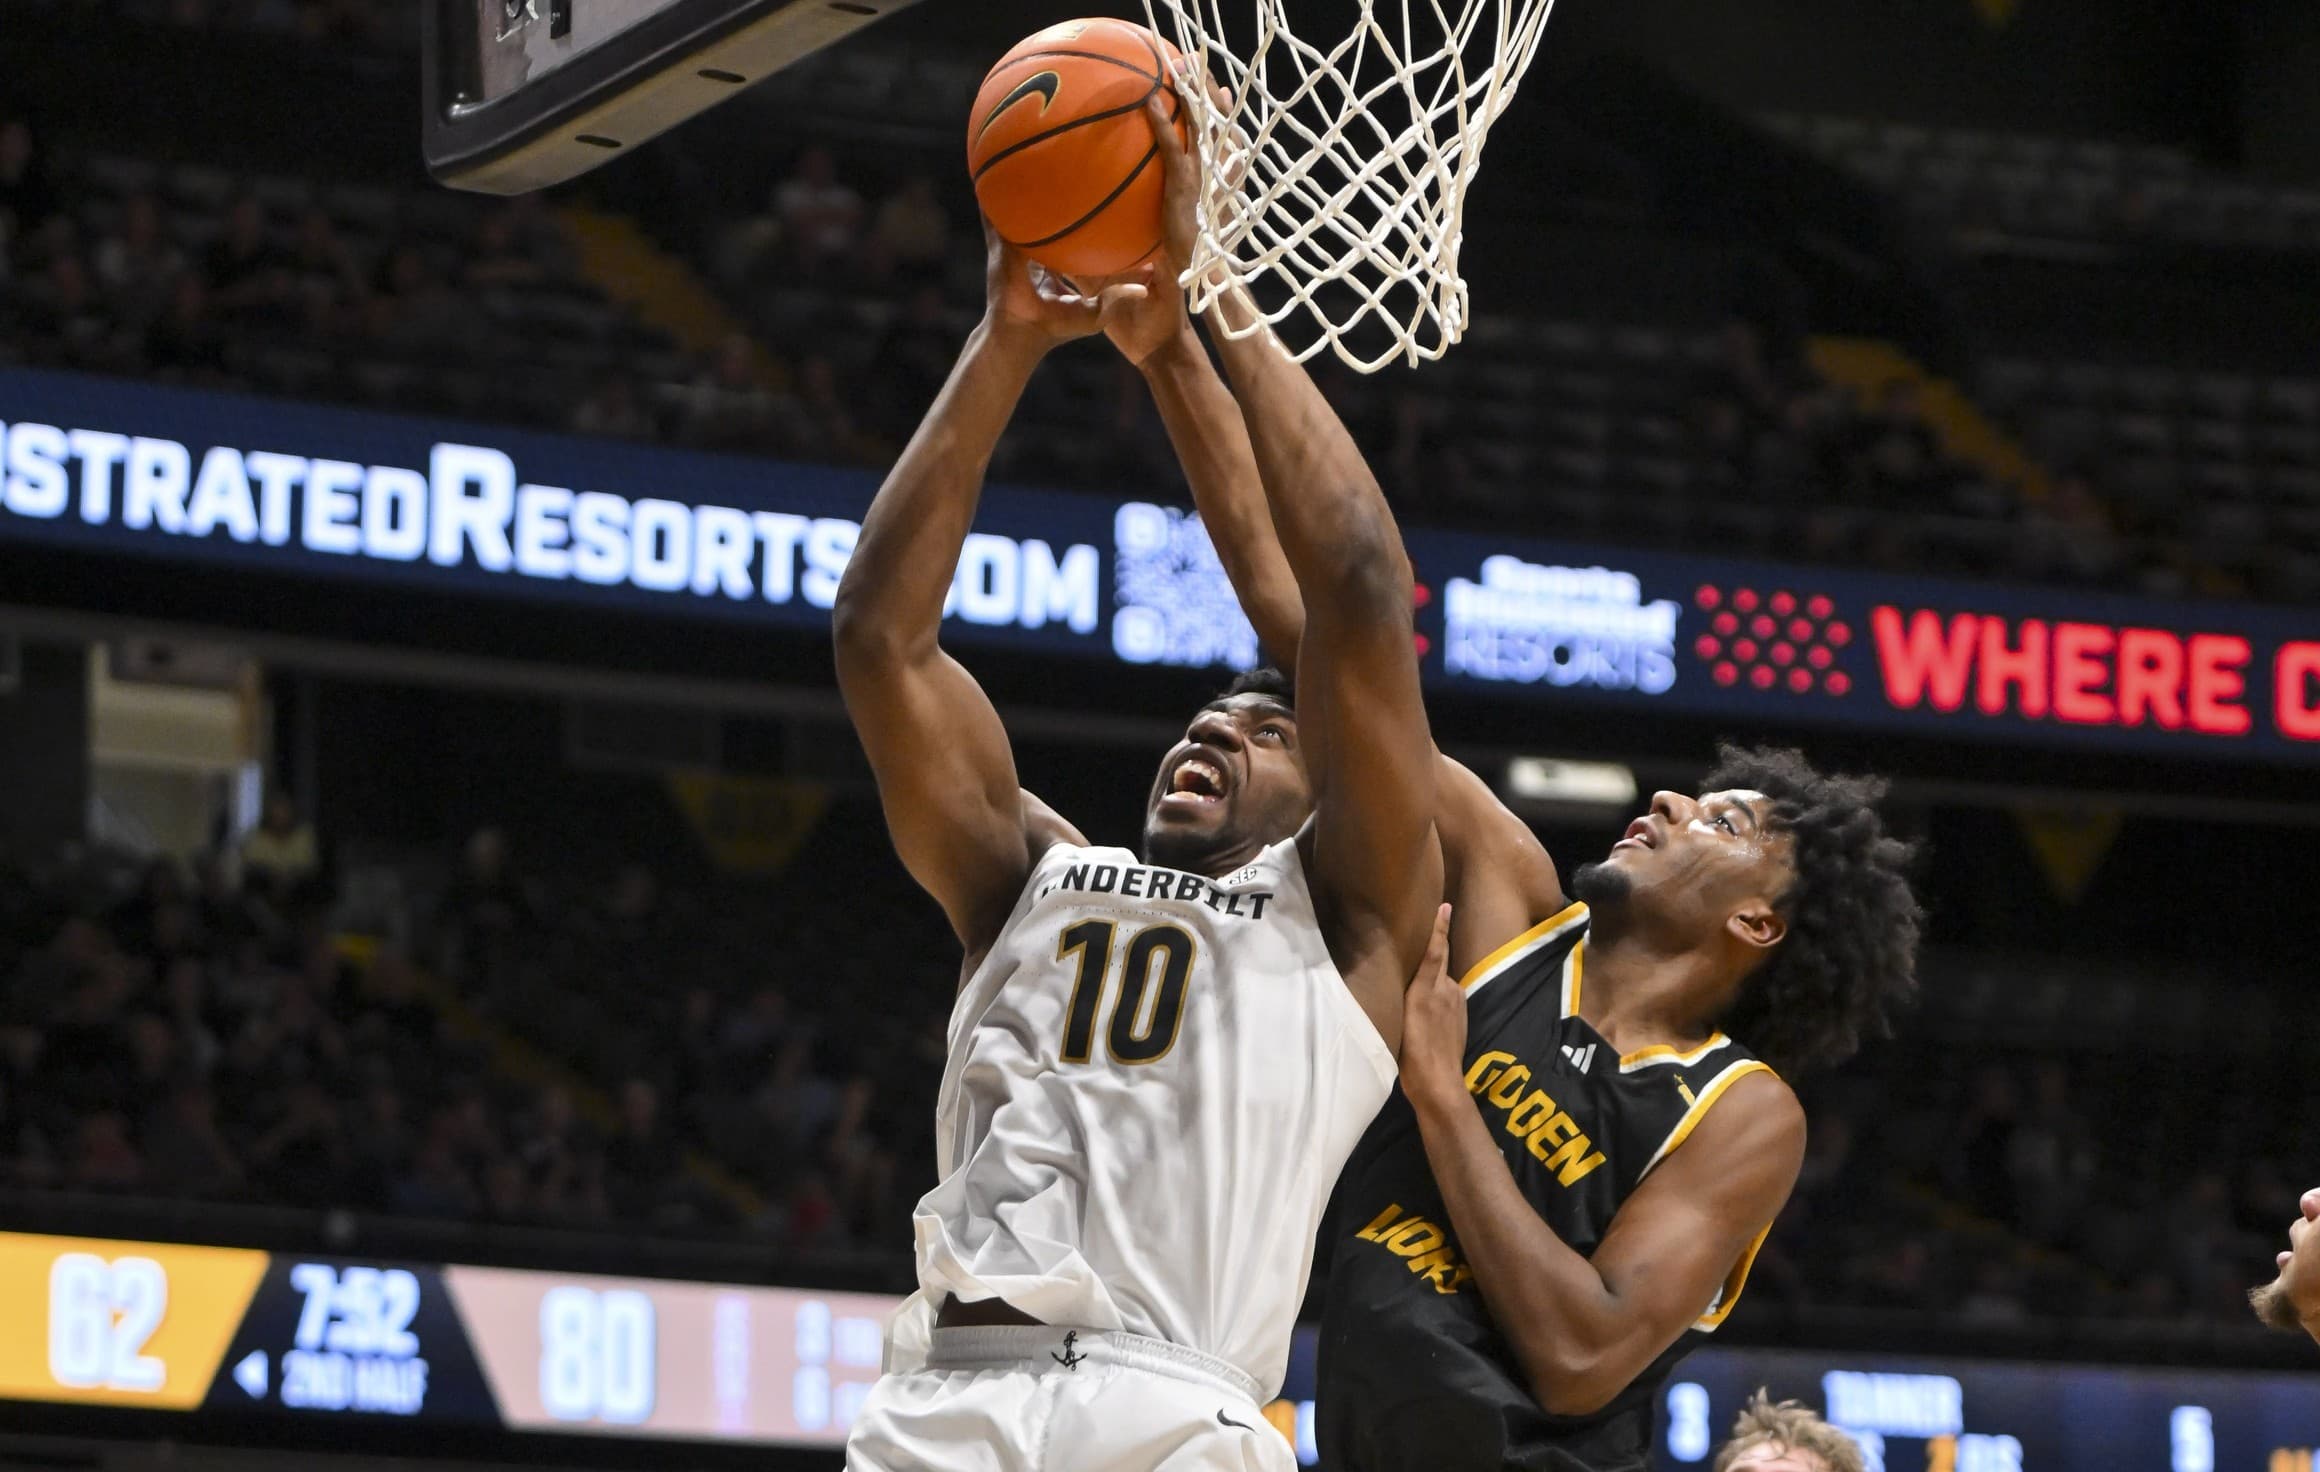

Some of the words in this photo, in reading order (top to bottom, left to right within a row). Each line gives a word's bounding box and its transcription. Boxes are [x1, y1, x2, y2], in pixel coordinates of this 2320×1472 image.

[1872, 605, 2253, 736] WHERE
[1042, 863, 1274, 920] NDERBILT
[1056, 917, 1197, 1066] 10
[48, 1252, 168, 1393] 62
[289, 1263, 421, 1356] 7:52
[540, 1285, 657, 1425] 80
